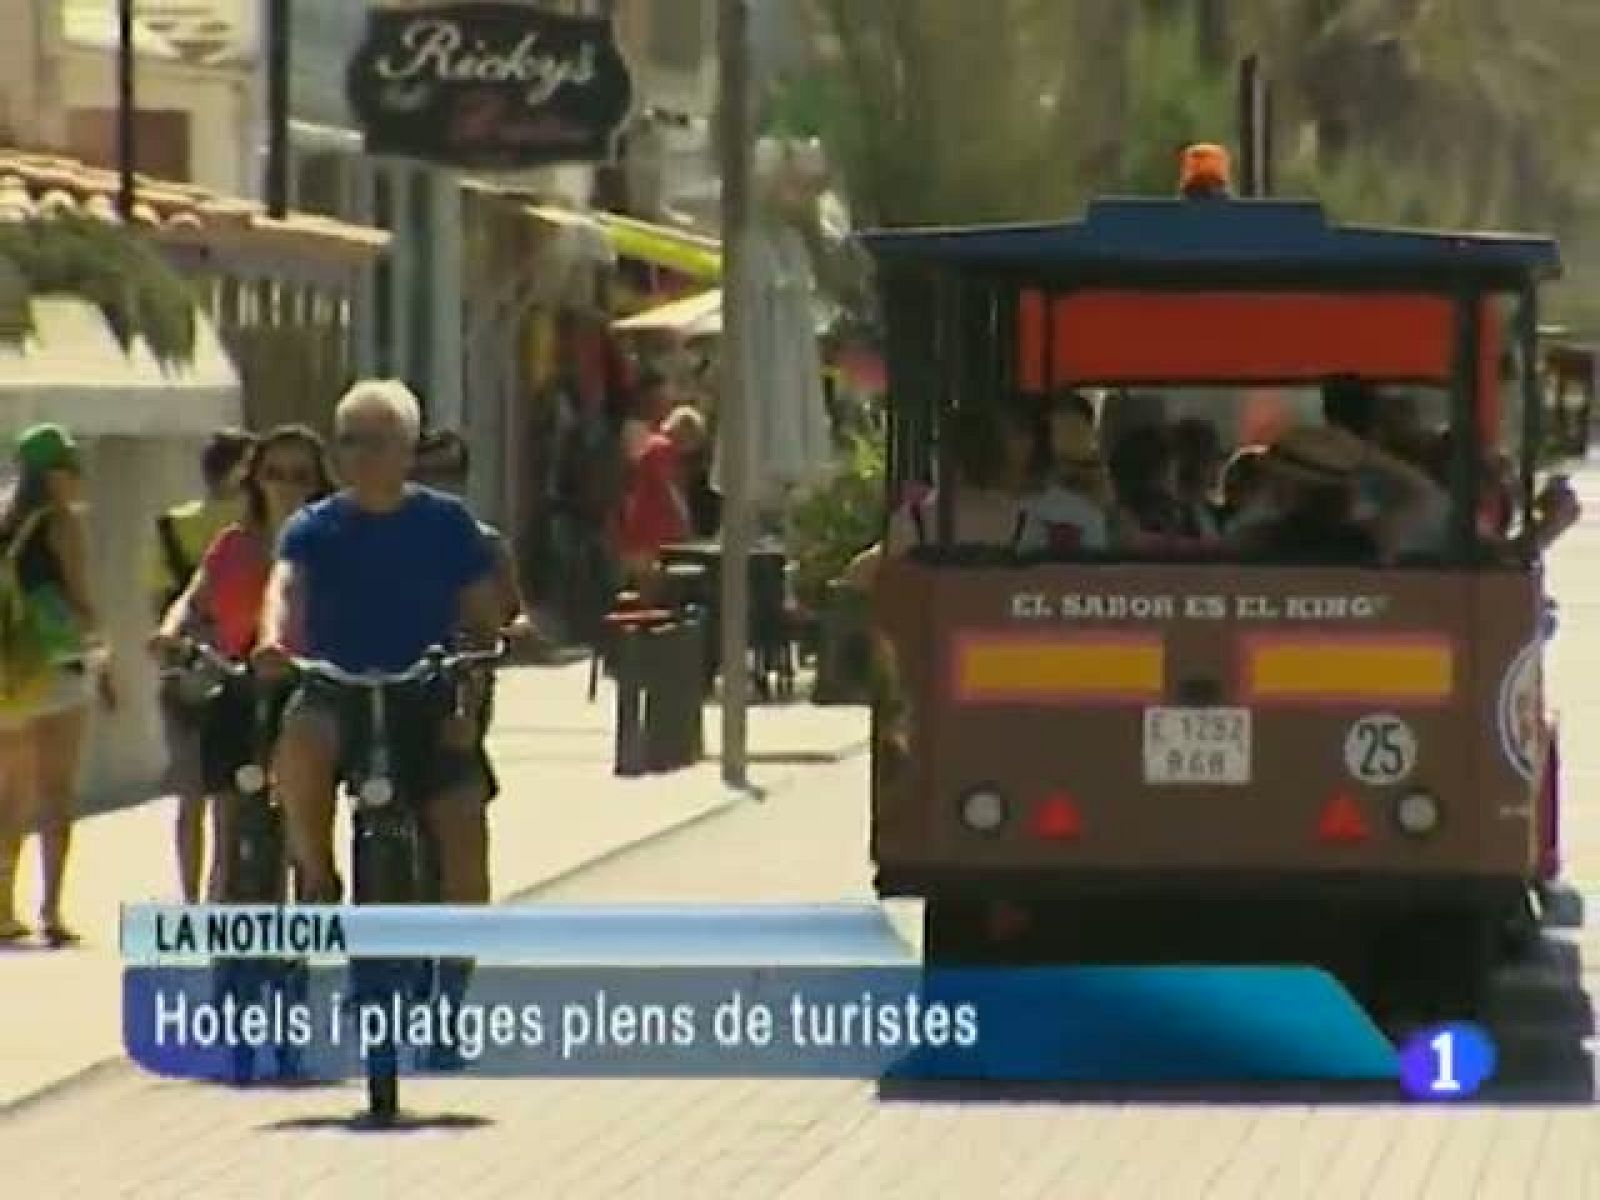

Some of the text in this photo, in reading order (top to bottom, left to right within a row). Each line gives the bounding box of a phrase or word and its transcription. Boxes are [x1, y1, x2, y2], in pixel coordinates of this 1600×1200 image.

[1011, 592, 1053, 620] EL
[1061, 592, 1173, 620] SABOR
[1183, 593, 1226, 619] ES
[1235, 593, 1279, 619] EL
[1357, 721, 1404, 776] 25
